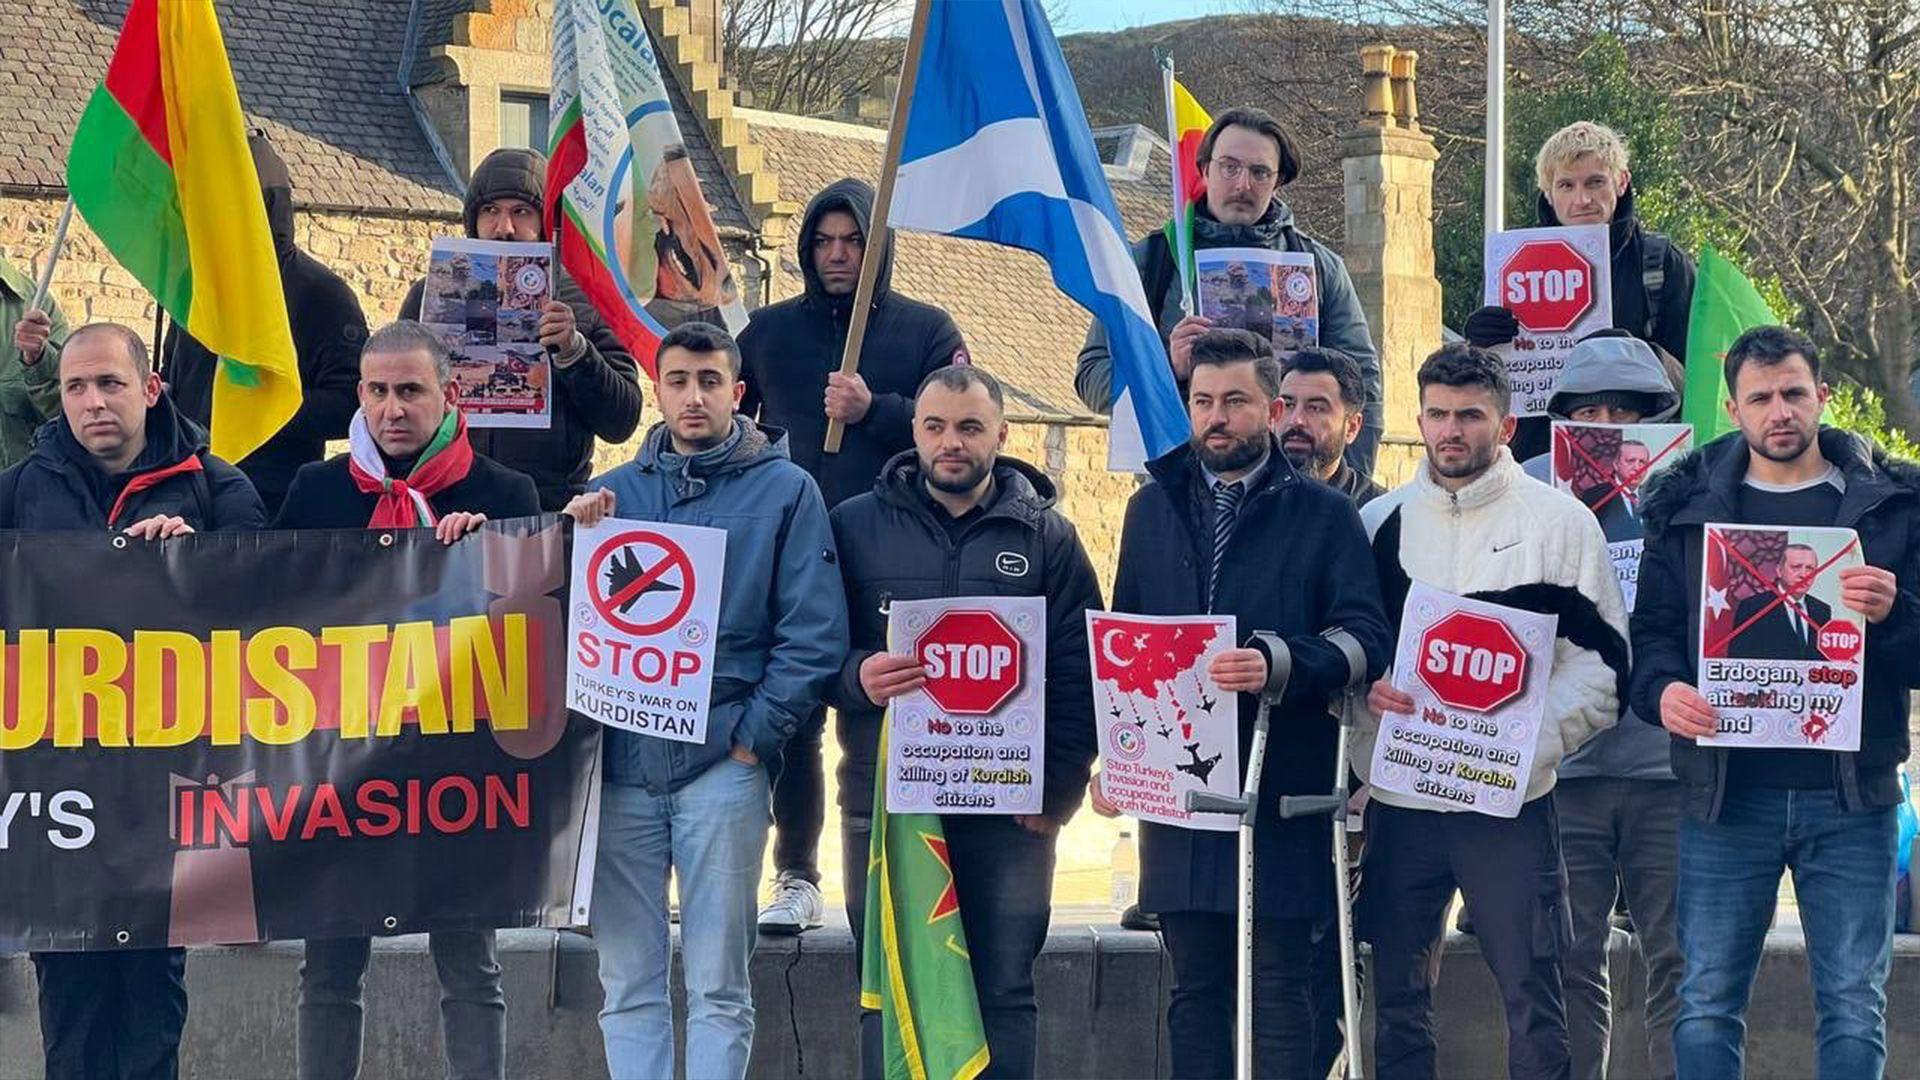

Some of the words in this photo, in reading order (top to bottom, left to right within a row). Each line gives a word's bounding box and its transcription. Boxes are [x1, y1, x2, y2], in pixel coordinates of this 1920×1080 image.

[1506, 269, 1583, 303] STOP
[1514, 337, 1535, 350] No
[1538, 337, 1554, 349] to
[1820, 634, 1859, 649] STOP
[577, 631, 702, 687] STOP
[923, 643, 1012, 681] STOP
[1426, 638, 1516, 685] STOP
[1706, 662, 1803, 685] Erdogan,
[1808, 666, 1857, 688] stop
[575, 673, 636, 703] TURKEY'S
[639, 693, 673, 710] WAR
[675, 699, 698, 712] ON
[1706, 690, 1805, 713] attacking
[1809, 693, 1841, 713] my
[575, 689, 696, 736] KURDISTAN
[1422, 706, 1447, 725] No
[1450, 713, 1468, 729] to
[1470, 716, 1498, 736] the
[928, 719, 952, 735] No
[955, 721, 973, 736] to
[977, 720, 1004, 736] the
[902, 744, 993, 761] occupation
[997, 745, 1030, 761] and
[1392, 726, 1483, 761] occupation
[1486, 747, 1520, 765] and
[899, 766, 946, 785] killing
[950, 768, 969, 782] of
[971, 767, 1031, 784] Kurdish
[1107, 759, 1132, 774] Stop
[1133, 762, 1175, 781] Turkey's
[1384, 746, 1432, 773] killing
[1435, 761, 1455, 774] of
[1456, 764, 1518, 790] Kurdish
[934, 792, 995, 807] citizens
[1108, 786, 1165, 804] occupation
[1167, 795, 1177, 805] of
[1150, 781, 1170, 793] and
[1414, 779, 1476, 805] citizens
[178, 773, 530, 847] INVASION
